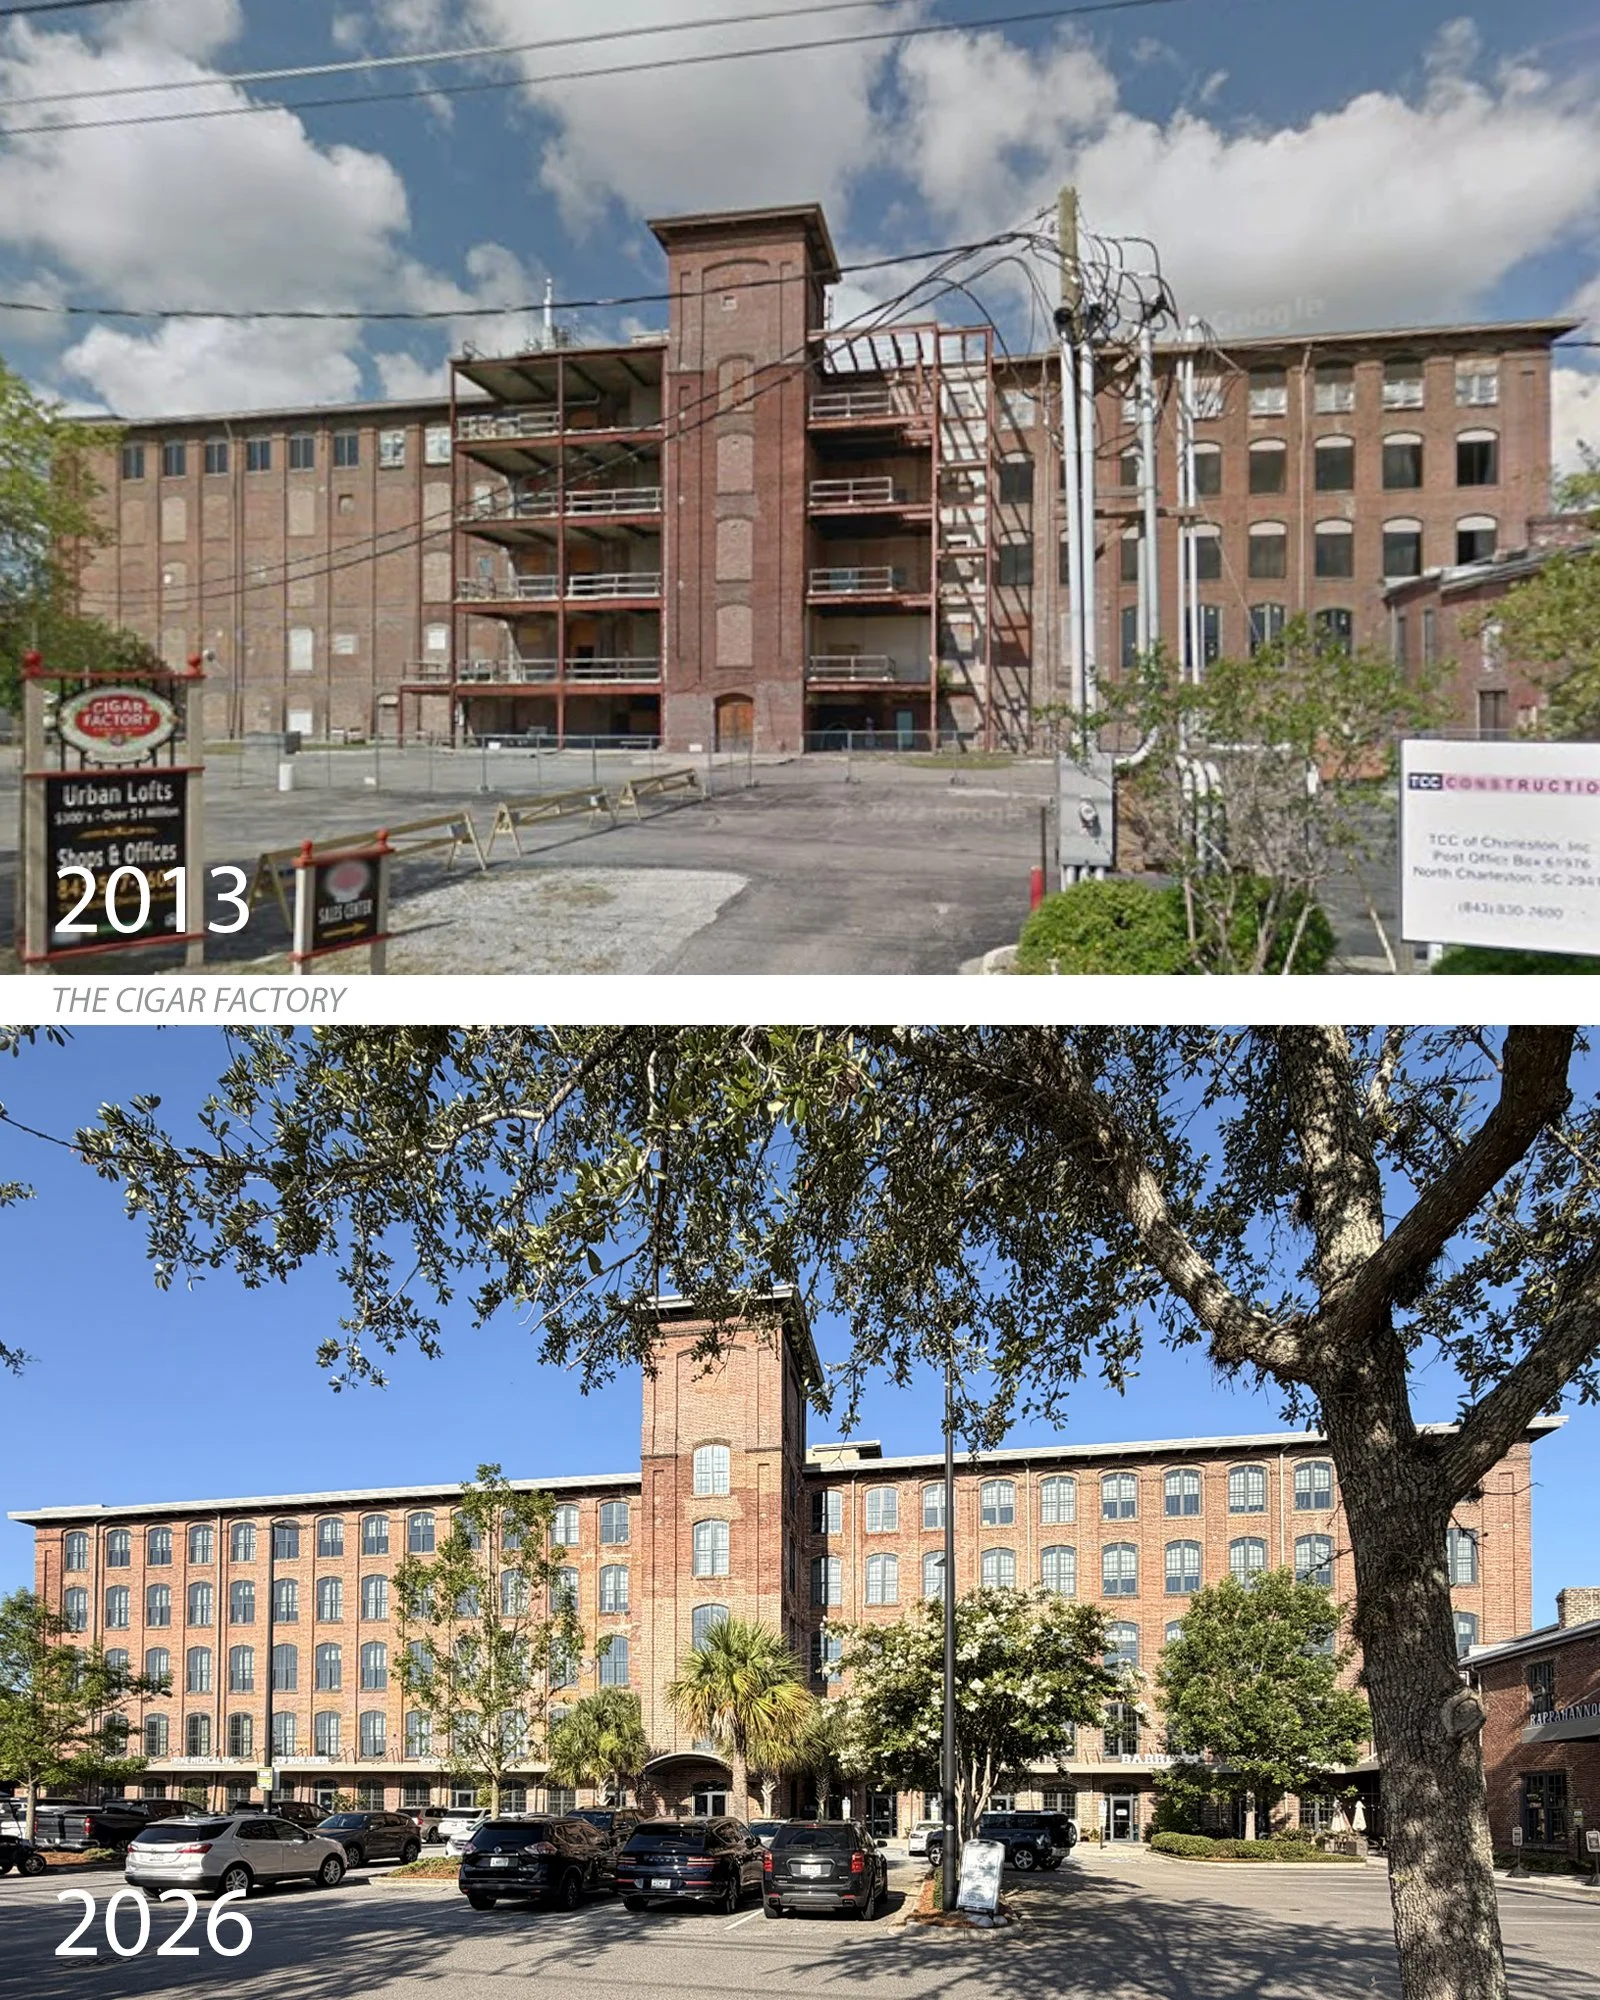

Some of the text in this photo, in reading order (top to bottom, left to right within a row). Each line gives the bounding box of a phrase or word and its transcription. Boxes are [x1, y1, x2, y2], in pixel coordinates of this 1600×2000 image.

[93, 700, 142, 713] CIGAR
[83, 713, 153, 726] FACTORY
[1410, 775, 1441, 788] TCC
[62, 780, 174, 806] Urban Lofts
[57, 840, 177, 872] Shops & Offices
